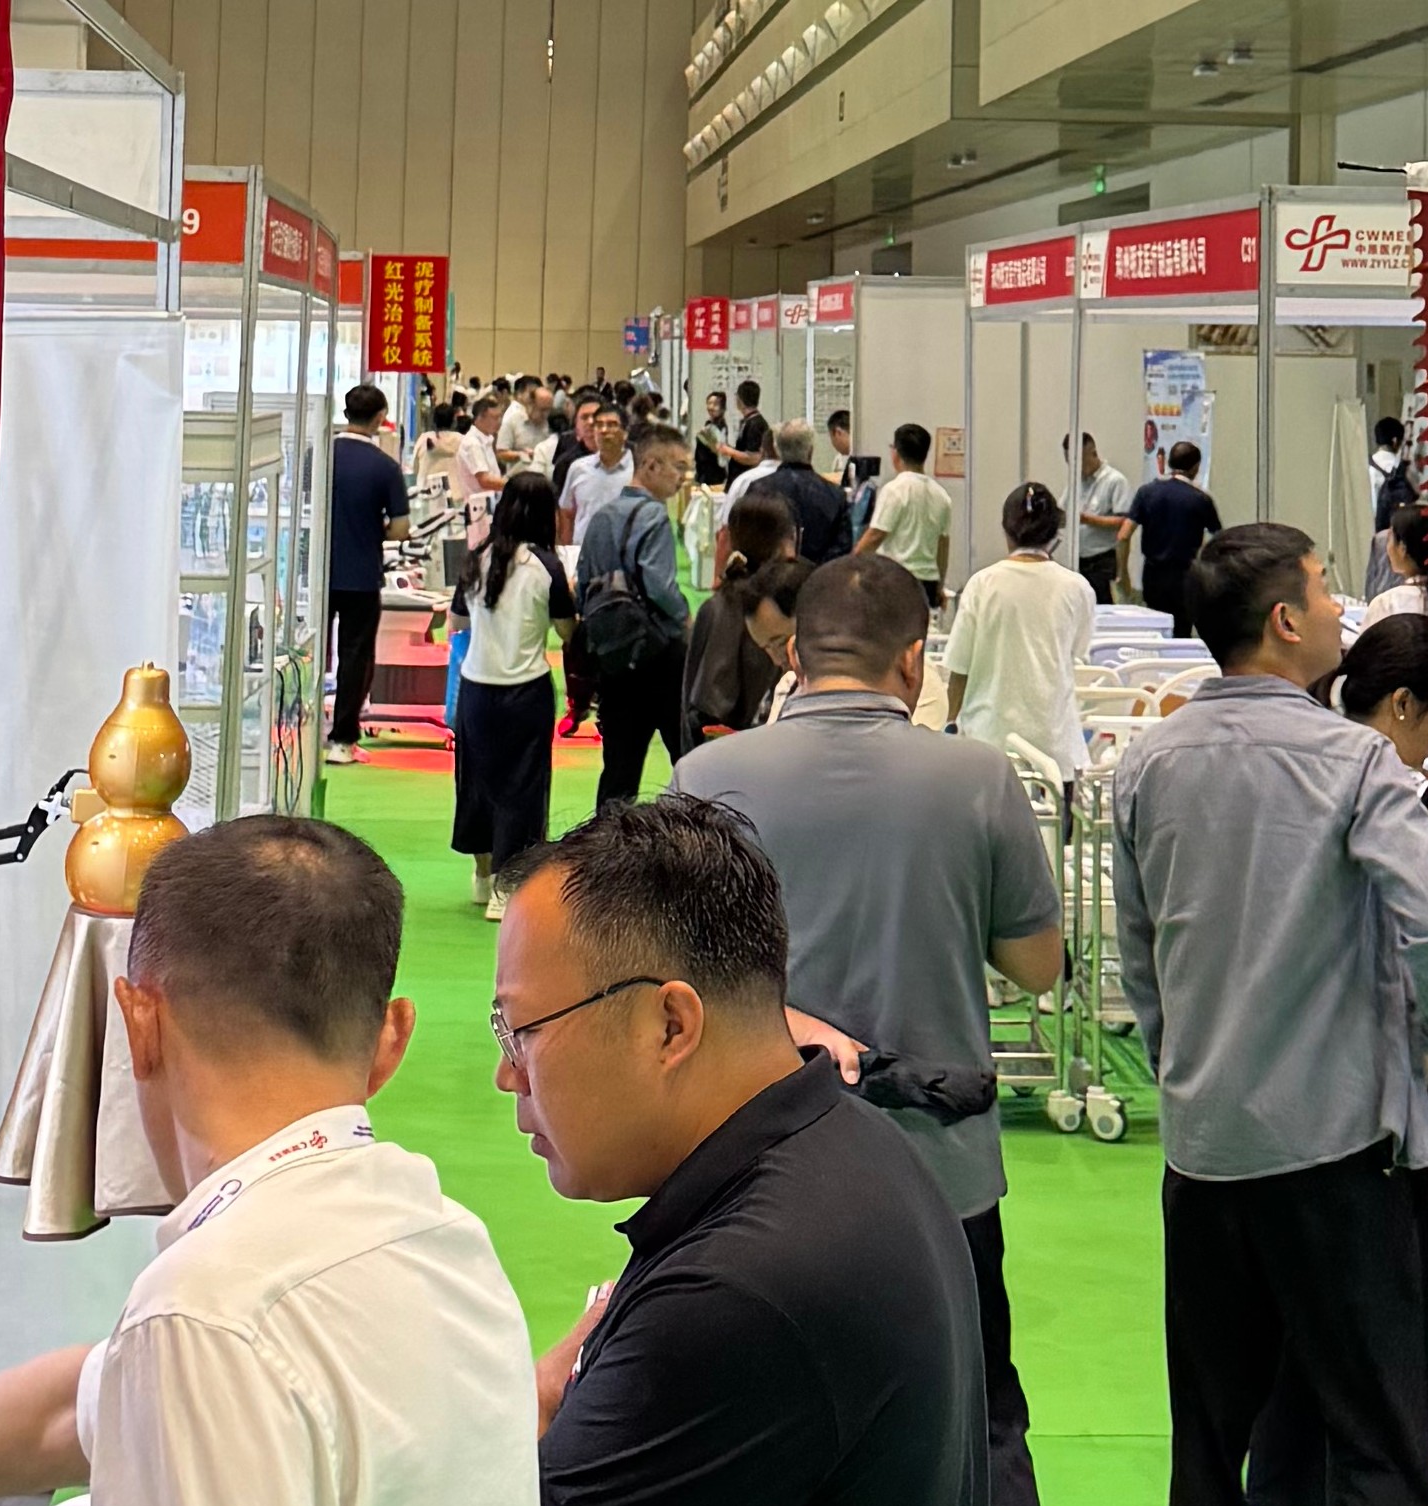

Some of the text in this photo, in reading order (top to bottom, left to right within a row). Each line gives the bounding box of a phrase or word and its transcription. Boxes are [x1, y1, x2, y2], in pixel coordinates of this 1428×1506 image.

[1341, 258, 1414, 270] WWW.ZYYLZ.C
[383, 260, 405, 365] 红光治疗仪
